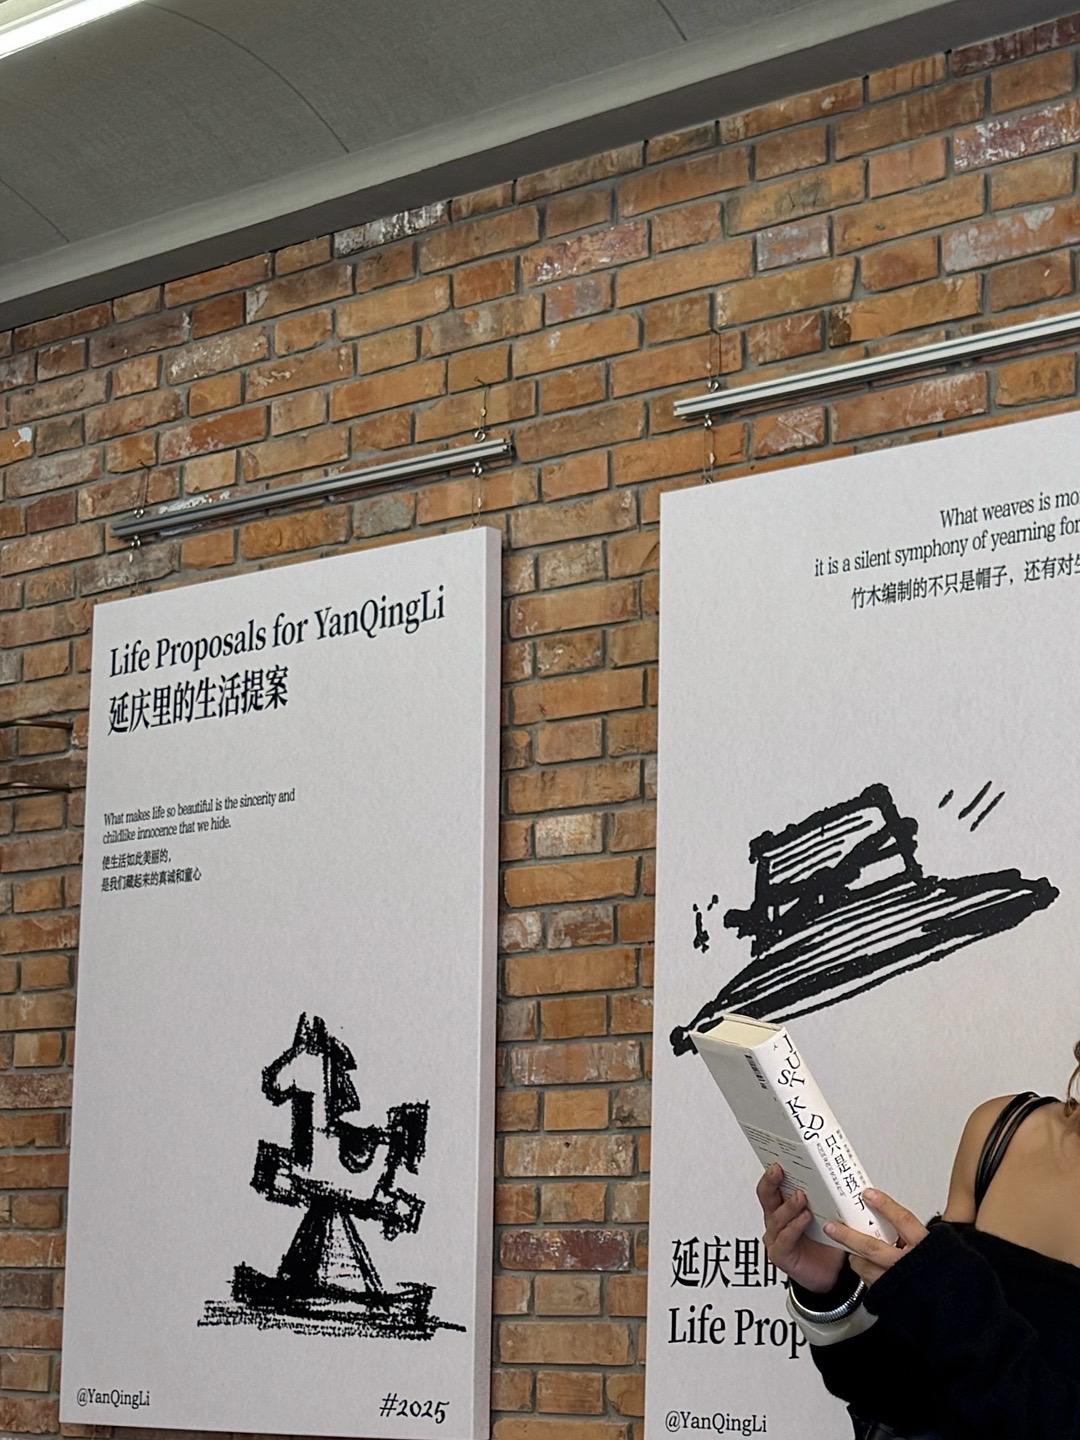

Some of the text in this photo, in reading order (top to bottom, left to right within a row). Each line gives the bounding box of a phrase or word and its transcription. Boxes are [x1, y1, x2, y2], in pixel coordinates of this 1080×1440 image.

[940, 506, 978, 528] What
[982, 499, 1034, 521] weaves
[1038, 492, 1051, 511] is
[815, 558, 824, 577] it
[828, 556, 839, 575] is
[842, 558, 850, 572] a
[854, 548, 891, 570] silent
[895, 538, 968, 567] symphony
[972, 529, 988, 550] of
[991, 521, 1056, 552] yearning
[109, 585, 445, 677] Life Proposals for YanQingLi
[108, 664, 288, 736] 延庆里的生活提案
[104, 788, 295, 826] What makes life so beautiful is the sincerity and
[103, 816, 231, 844] childlike innocence that we hide.
[825, 1134, 865, 1211] 只是孩子
[668, 1304, 725, 1344] Life
[77, 1388, 150, 1409] @YanQingLi
[379, 1393, 450, 1424] #2025
[665, 1410, 767, 1436] @YanQingLi
